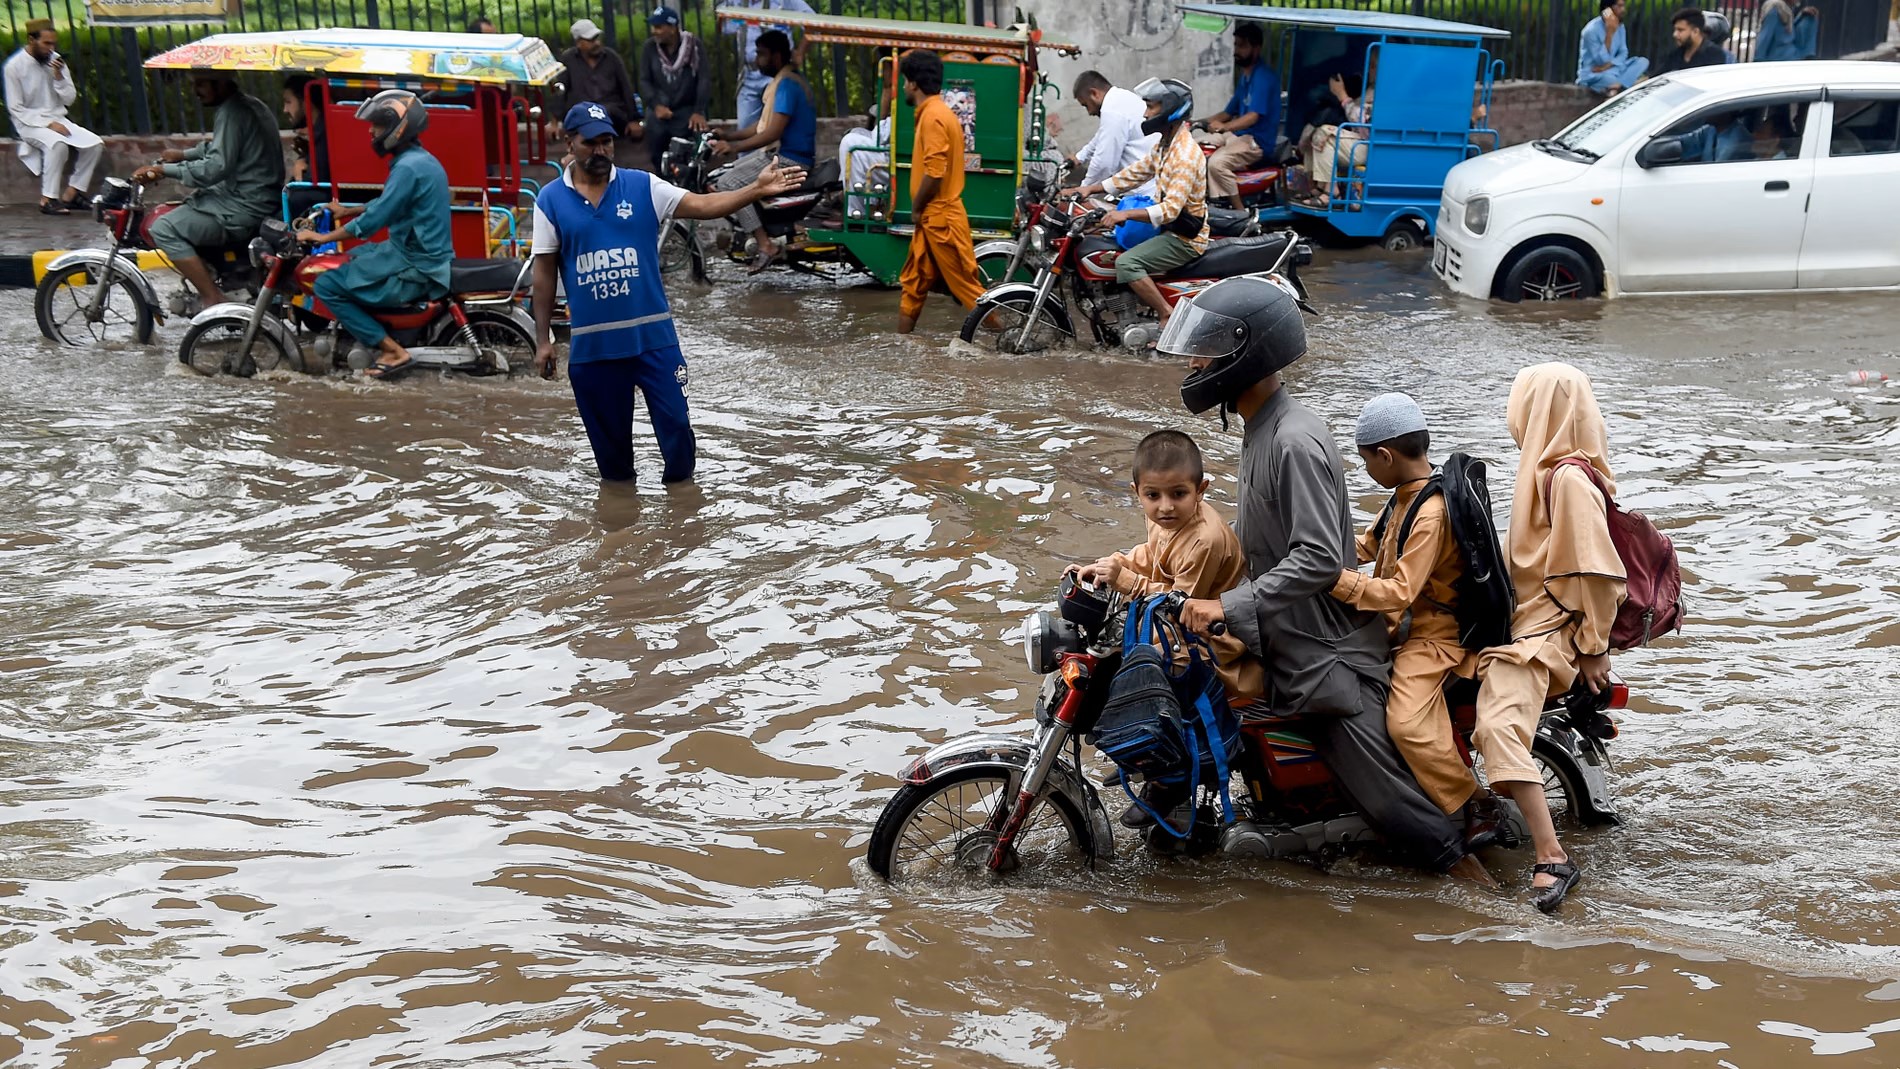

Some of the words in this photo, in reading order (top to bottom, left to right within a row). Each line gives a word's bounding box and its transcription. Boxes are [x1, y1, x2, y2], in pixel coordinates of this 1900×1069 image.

[576, 247, 638, 274] WASA
[577, 267, 640, 286] LAHORE
[591, 279, 631, 300] 1334
